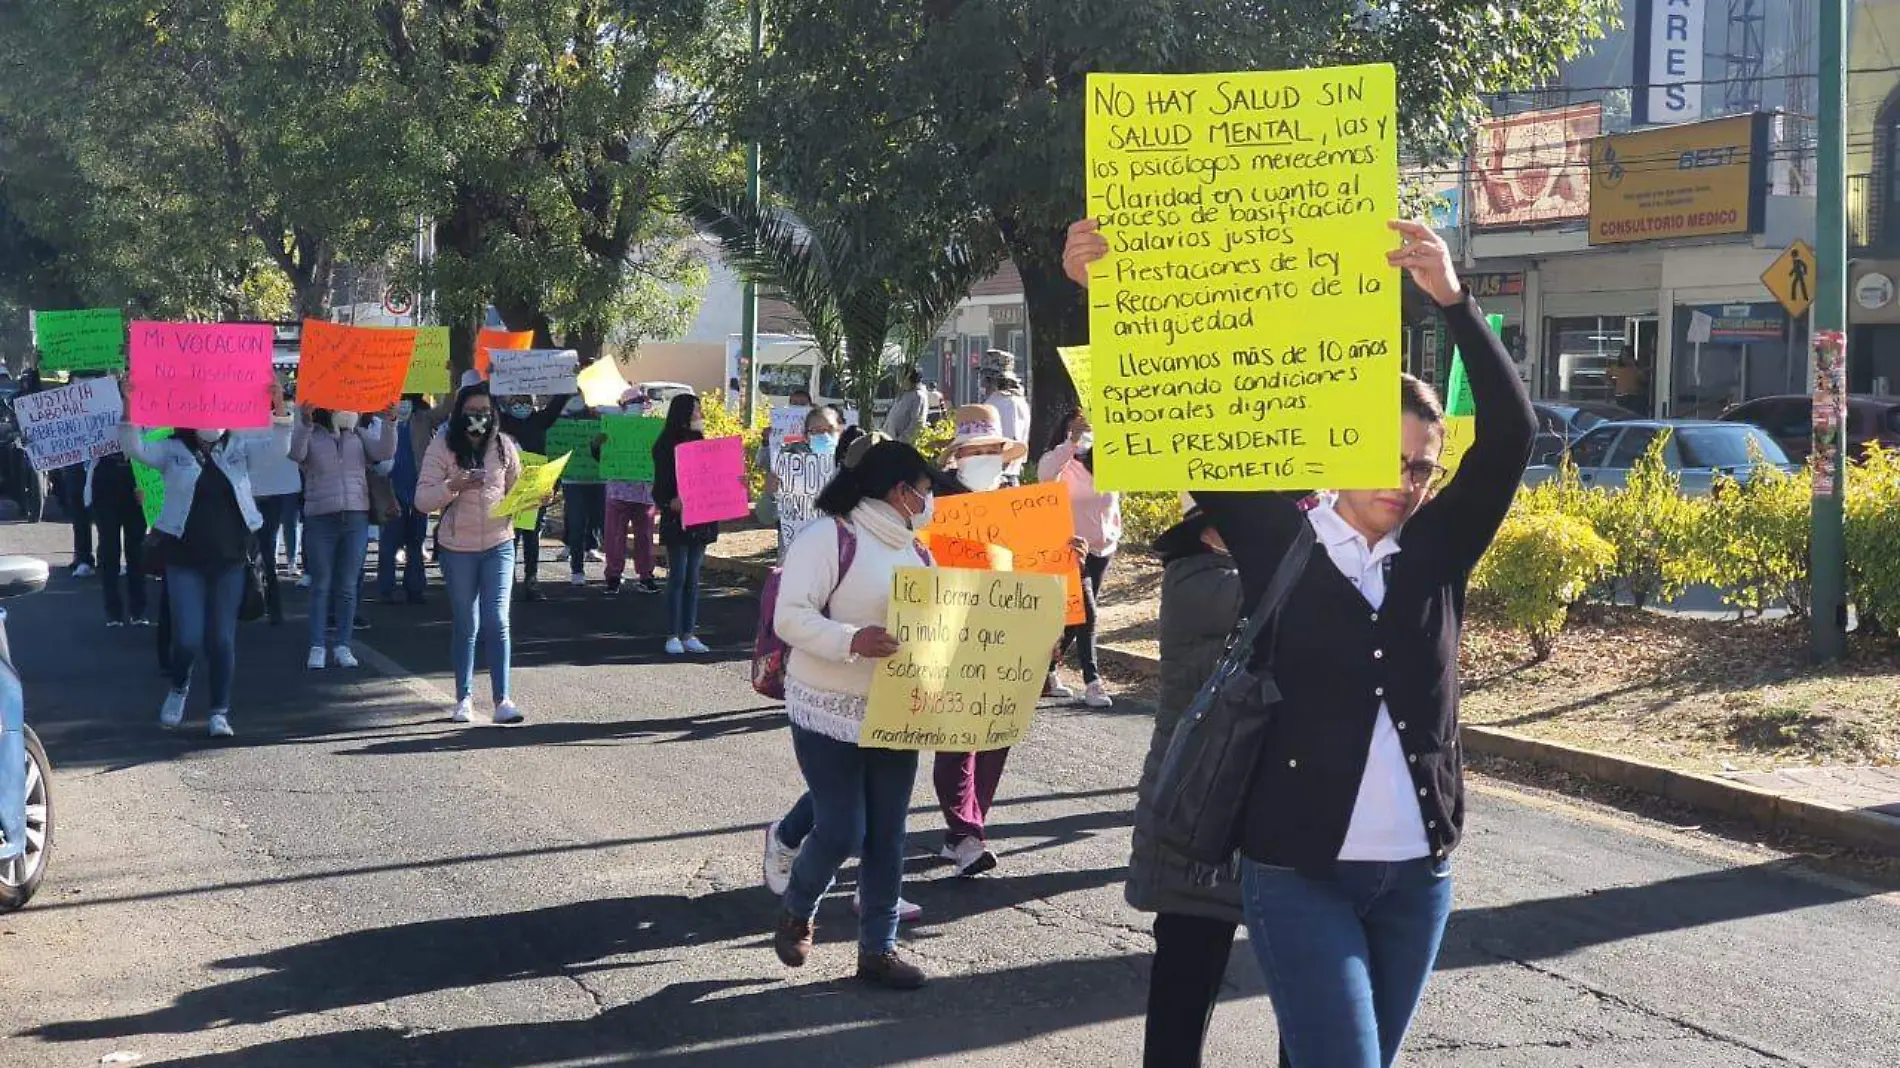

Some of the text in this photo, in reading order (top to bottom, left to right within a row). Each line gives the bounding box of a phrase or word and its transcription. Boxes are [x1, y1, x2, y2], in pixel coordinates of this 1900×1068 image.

[1665, 0, 1690, 111] RES
[1095, 76, 1364, 118] NO HAY SALUD SIN
[1108, 124, 1192, 150] SALUD
[1335, 116, 1369, 138] las
[1092, 158, 1119, 179] los
[1130, 154, 1241, 184] psicólogos
[1211, 186, 1243, 203] en
[1251, 181, 1330, 203] cuanto
[1338, 174, 1360, 197] al
[1097, 196, 1375, 230] proceso de basificación
[1601, 209, 1738, 237] CONSULTORIO MEDICO
[1114, 225, 1295, 253] Salarios justos
[1116, 257, 1261, 283] Prestaciones
[1270, 252, 1298, 272] de
[1308, 248, 1340, 276] ley
[1115, 280, 1299, 315] Reconocimiento
[1311, 277, 1343, 297] de
[1358, 273, 1381, 294] la
[1114, 307, 1254, 346] antigüedad
[175, 330, 264, 355] VOCACION
[154, 361, 177, 381] No
[1119, 338, 1388, 378] Llevamos más de 10 años
[1103, 376, 1221, 405] esperando
[1233, 366, 1359, 391] condiciones
[1105, 403, 1215, 424] laborales
[1126, 432, 1162, 456] EL
[1171, 428, 1307, 453] PRESIDENTE
[1329, 427, 1360, 447] LO
[1010, 493, 1059, 519] para
[936, 576, 980, 606] Lorena
[989, 578, 1041, 611] Cuellar
[896, 615, 909, 643] la
[958, 625, 970, 642] a
[977, 628, 1006, 651] que
[960, 664, 986, 681] con
[998, 655, 1034, 682] solo
[969, 697, 987, 717] al
[961, 732, 976, 746] su
